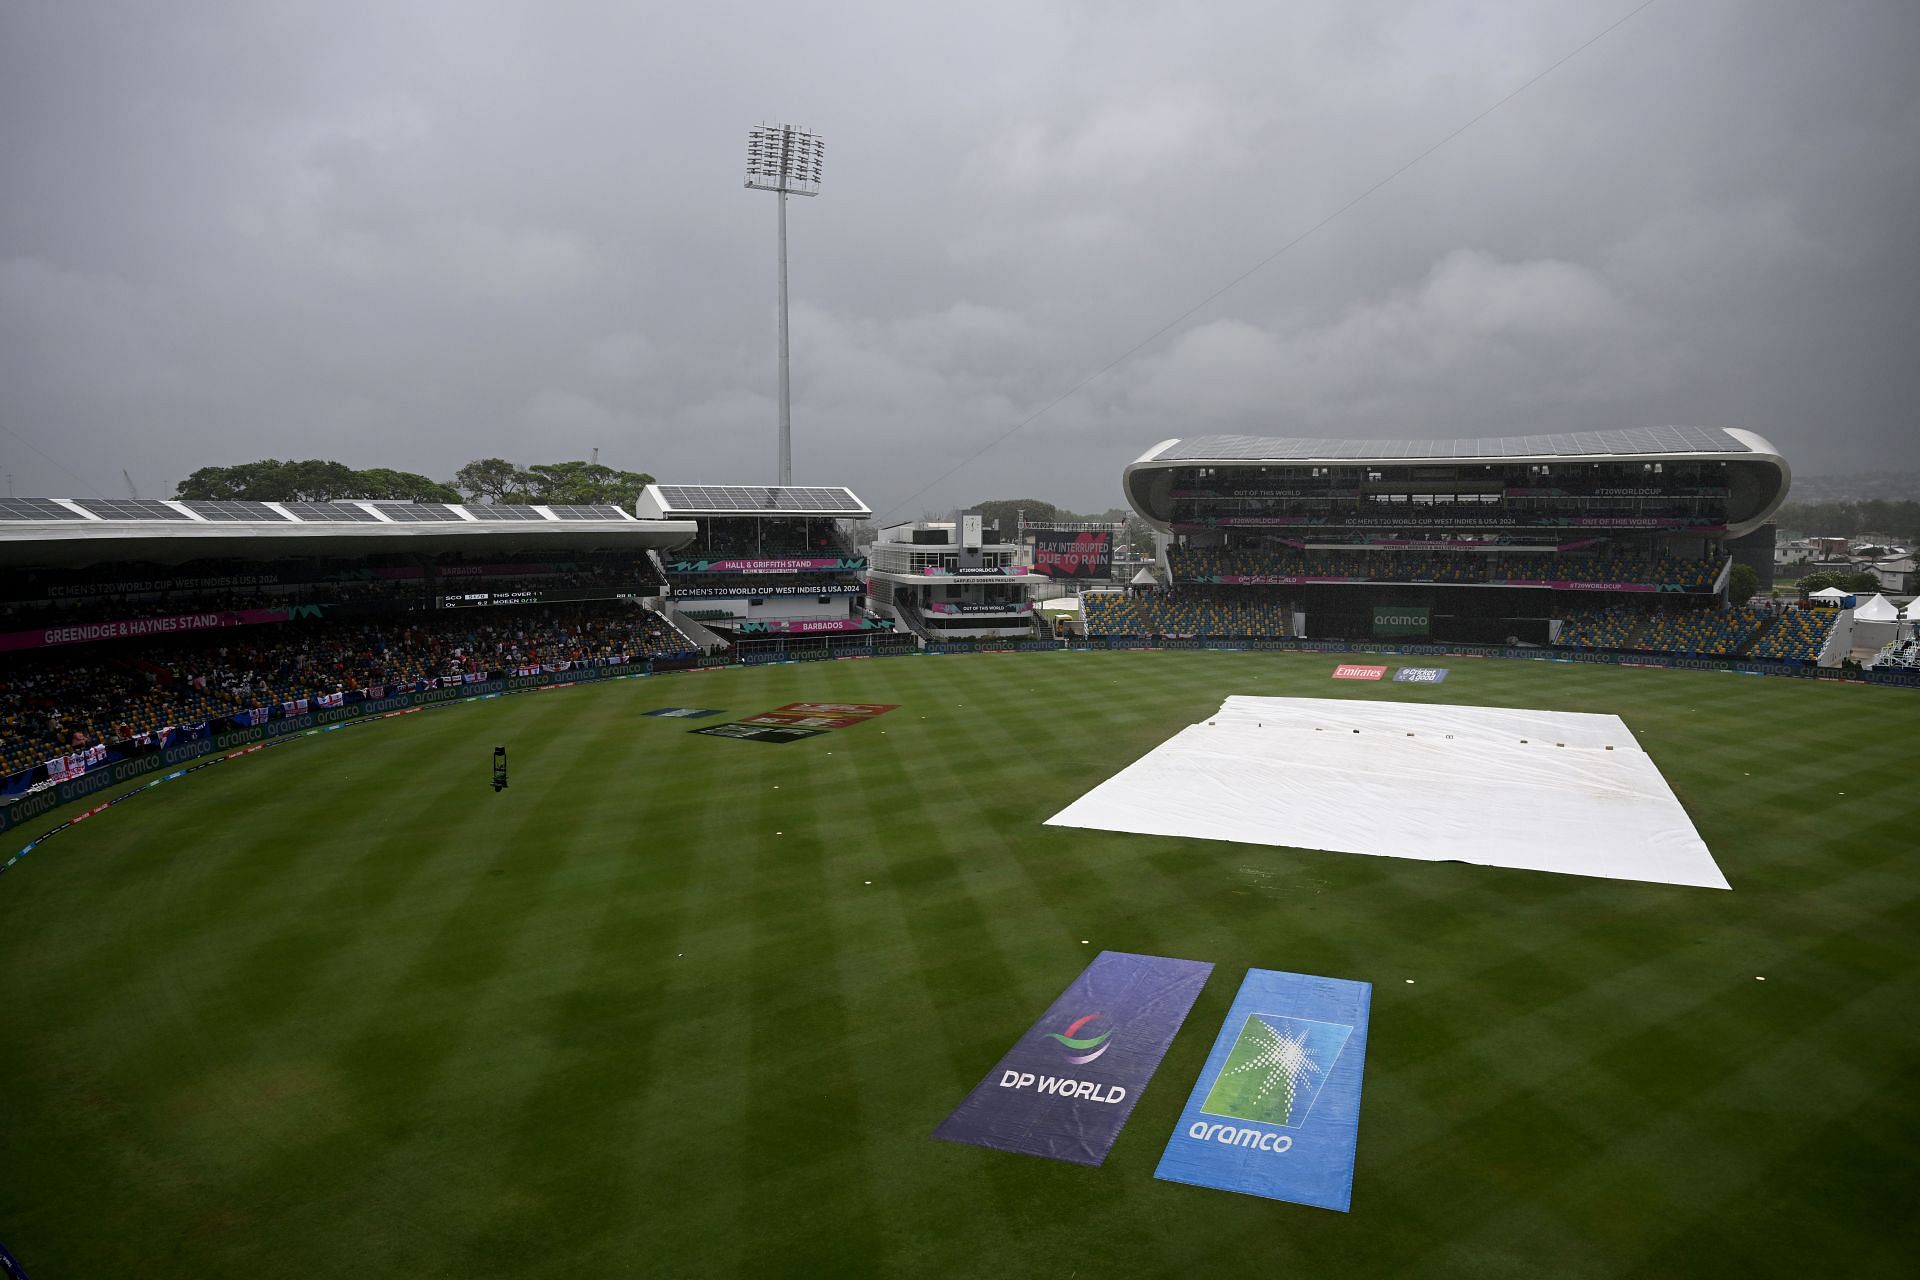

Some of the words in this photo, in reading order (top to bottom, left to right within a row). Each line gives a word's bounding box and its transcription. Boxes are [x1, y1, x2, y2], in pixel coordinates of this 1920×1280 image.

[1039, 542, 1057, 552] PLAY
[1058, 543, 1109, 553] INTERRUPTED
[725, 561, 745, 569] HALL
[1038, 554, 1061, 564] DUE
[1063, 554, 1079, 564] TO
[1082, 554, 1109, 565] RAIN
[689, 588, 713, 596] MEN'S
[797, 586, 820, 594] INDIES
[1374, 614, 1428, 626] aramco
[44, 622, 117, 644] GREENIDGE
[119, 622, 128, 635] &
[130, 618, 177, 634] HAYNES
[179, 615, 218, 630] STAND
[802, 621, 843, 631] BARBADOS
[878, 645, 916, 654] aramco
[928, 642, 969, 650] aramco
[975, 641, 1014, 650] aramco
[1020, 640, 1060, 649] aramco
[1067, 640, 1105, 649] aramco
[1112, 640, 1152, 648] aramco
[1158, 640, 1200, 648] aramco
[1206, 640, 1247, 649] aramco
[1252, 641, 1296, 649] aramco
[1301, 641, 1346, 650] aramco
[1351, 643, 1395, 651] aramco
[1402, 644, 1447, 653] aramco
[790, 649, 829, 660] aramco
[833, 646, 873, 656] aramco
[1453, 646, 1500, 655] aramco
[1506, 649, 1554, 658] aramco
[747, 652, 785, 663] aramco
[1561, 652, 1610, 661] aramco
[1618, 655, 1668, 665] aramco
[1676, 658, 1729, 669] aramco
[1736, 662, 1791, 674] aramco
[554, 668, 596, 682] aramco
[600, 663, 641, 676] aramco
[1336, 667, 1382, 678] Emirates
[1800, 666, 1857, 679] aramco
[508, 674, 549, 688] aramco
[462, 680, 503, 695] aramco
[415, 687, 457, 703] aramco
[365, 695, 409, 713] aramco
[317, 705, 360, 723] aramco
[267, 716, 312, 735] aramco
[217, 727, 262, 748] aramco
[166, 739, 211, 764] aramco
[115, 754, 160, 779] aramco
[62, 770, 111, 799] aramco
[11, 791, 57, 822] aramco
[1000, 1069, 1034, 1088] DP
[1036, 1075, 1127, 1105] WORLD
[1188, 1121, 1293, 1154] aramco
